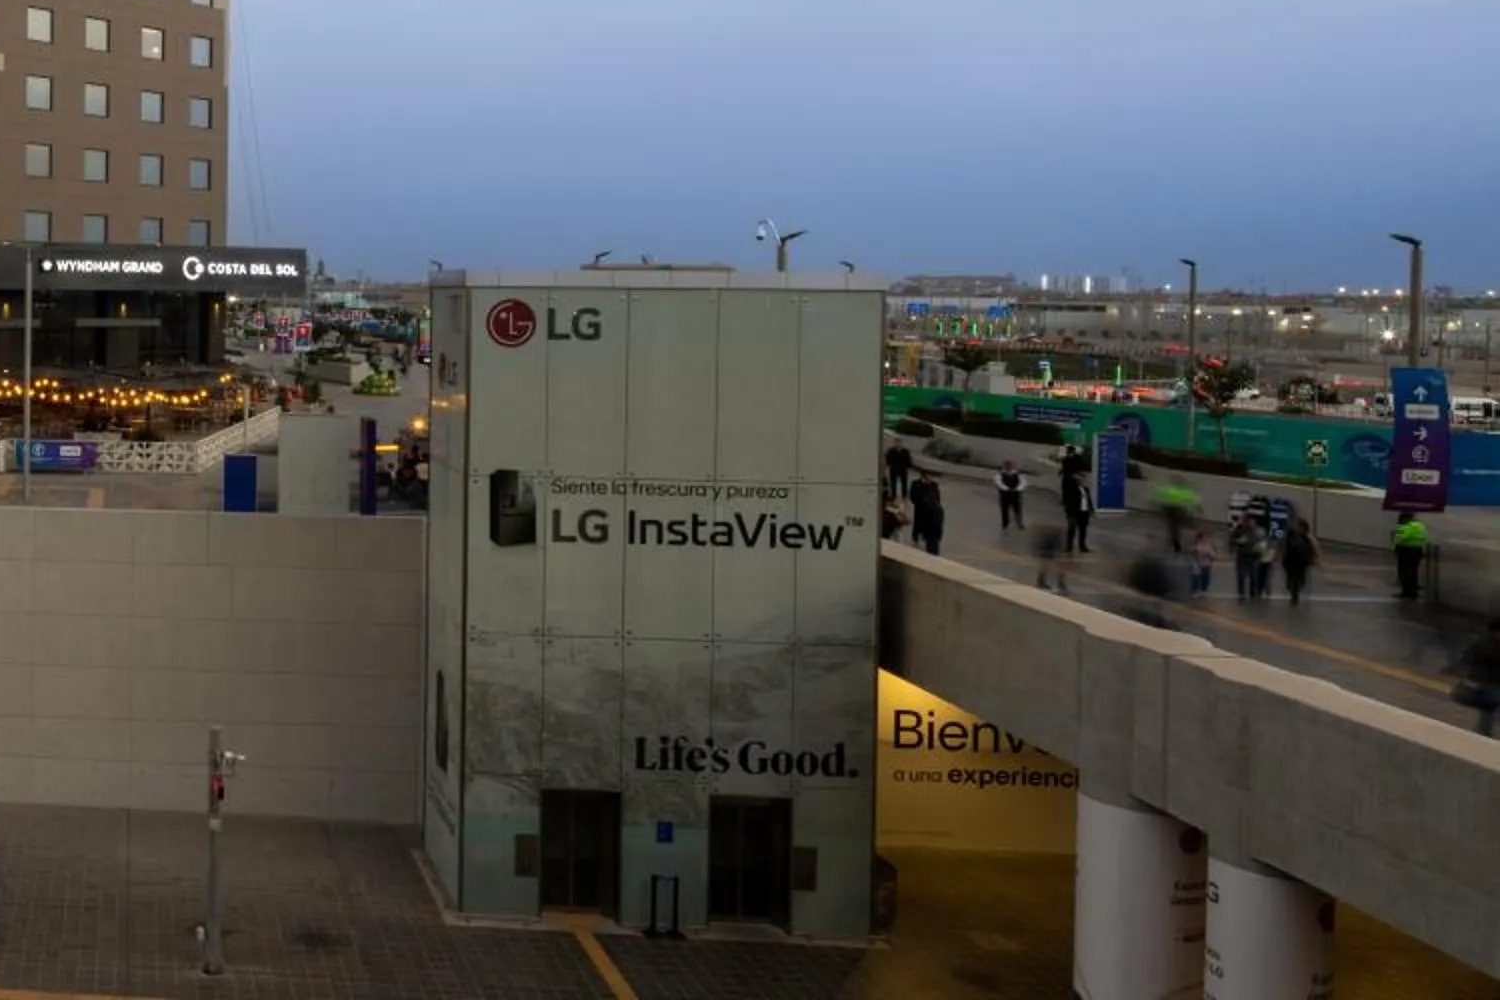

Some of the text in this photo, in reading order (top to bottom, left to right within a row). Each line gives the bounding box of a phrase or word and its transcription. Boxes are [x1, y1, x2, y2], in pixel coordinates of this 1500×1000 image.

[56, 260, 164, 273] WYNDHAM GRAND
[207, 263, 298, 276] COSTA DEL SOL
[546, 307, 602, 341] LG
[551, 478, 790, 501] Siente la frescura y pureza
[551, 509, 610, 544] LG
[893, 709, 1048, 756] Bienv
[634, 736, 859, 779] Life's Good.
[893, 766, 1080, 789] a una experienci
